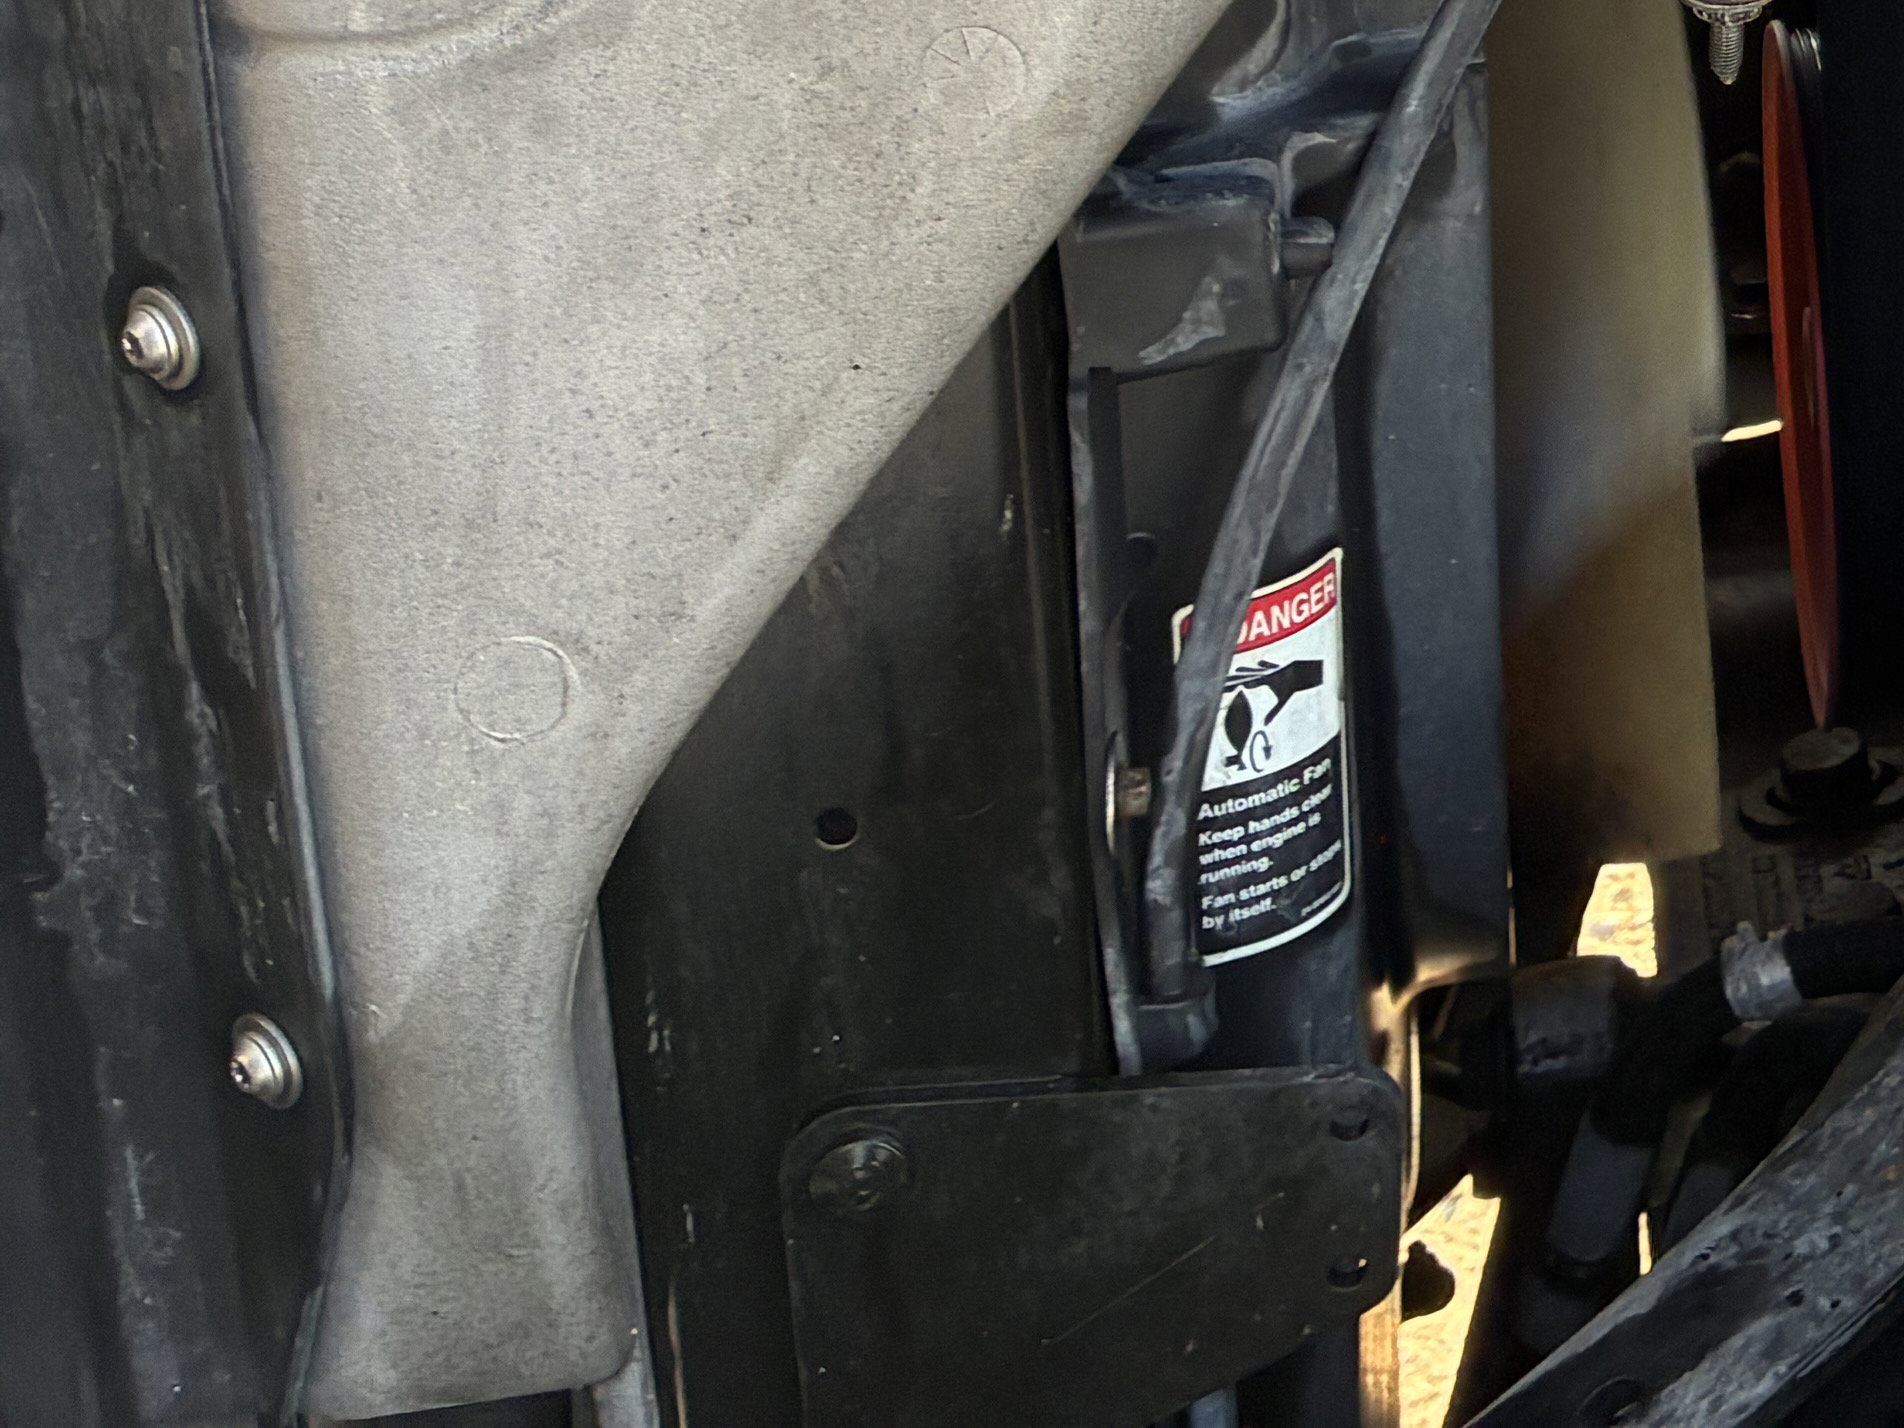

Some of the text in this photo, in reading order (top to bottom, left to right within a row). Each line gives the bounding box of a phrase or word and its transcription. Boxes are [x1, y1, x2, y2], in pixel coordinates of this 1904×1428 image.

[1197, 758, 1332, 820] Automatic Fan
[1198, 825, 1245, 846] Keep
[1248, 805, 1300, 834] hands
[1199, 812, 1322, 865] when engine is
[1198, 856, 1275, 885] running.
[1201, 893, 1236, 910] Fan
[1239, 875, 1289, 901] starts
[1290, 865, 1309, 882] or
[1202, 914, 1225, 930] by
[1229, 897, 1277, 923] itself.
